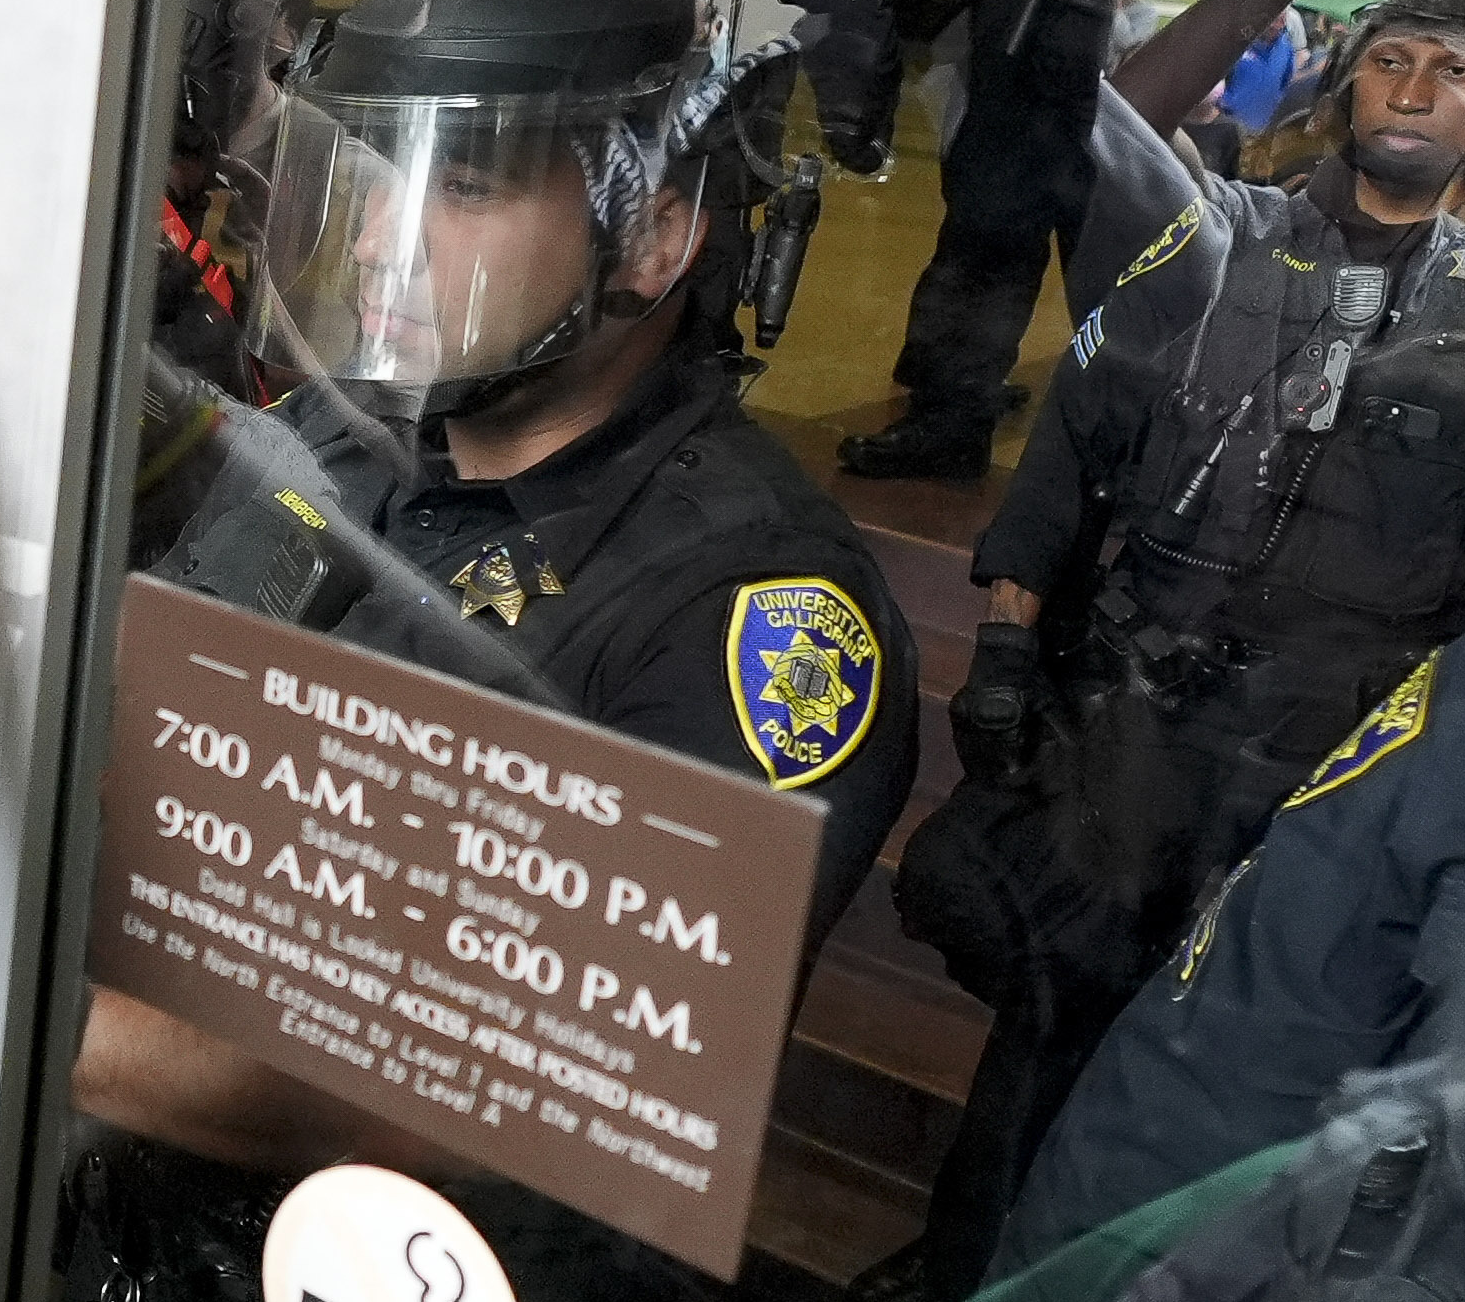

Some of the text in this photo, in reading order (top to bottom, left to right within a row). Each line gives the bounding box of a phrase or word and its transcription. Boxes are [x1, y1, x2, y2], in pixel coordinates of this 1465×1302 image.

[753, 590, 876, 660] UNIVERSITY OF
[767, 609, 867, 668] CALIFORNIA
[263, 666, 623, 826] BUILDING HOURS
[319, 733, 546, 843] Monday thru Friday
[758, 718, 823, 764] POLICE
[153, 707, 251, 778] 7:00
[261, 753, 375, 828] A.M.
[447, 821, 590, 909] 10:00
[604, 876, 733, 965] P.M.
[300, 816, 543, 937] Saturday and Sunday
[155, 795, 253, 867] 9:00
[263, 843, 377, 920] A.M.
[446, 914, 564, 994] 6:00
[578, 962, 704, 1055] P.M.
[252, 891, 296, 928] Hall
[301, 912, 322, 941] is
[329, 921, 404, 975] Locked
[410, 957, 527, 1030] University
[533, 1009, 636, 1075] Holidays
[121, 911, 158, 945] Use
[164, 931, 196, 961] the
[202, 945, 259, 990] North
[265, 972, 360, 1035] Entrance
[367, 1020, 394, 1050] to
[398, 1033, 462, 1079] Level
[487, 1078, 535, 1112] and
[539, 1098, 580, 1133] the
[129, 872, 719, 1152] THIS ENTRANCE HAS NO KEY ACCESS AFTER POSTED HOURS
[279, 1008, 502, 1128] Entrance to Level A
